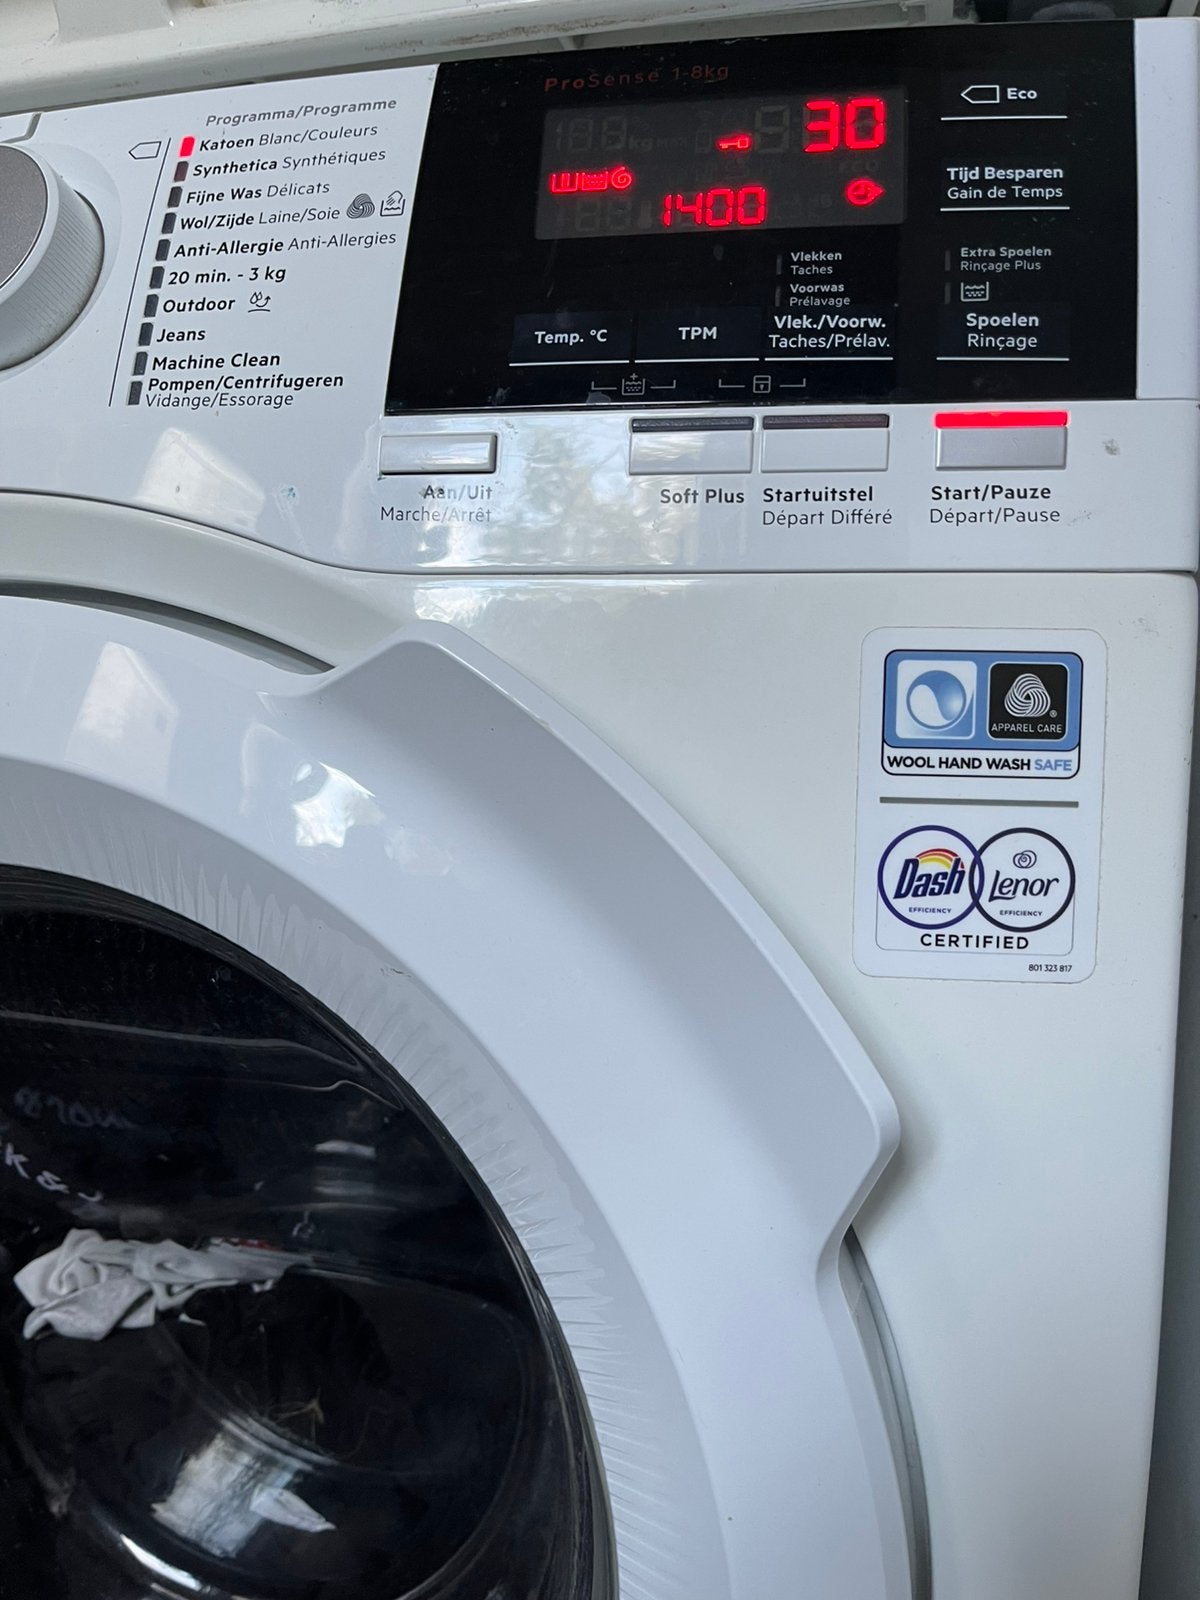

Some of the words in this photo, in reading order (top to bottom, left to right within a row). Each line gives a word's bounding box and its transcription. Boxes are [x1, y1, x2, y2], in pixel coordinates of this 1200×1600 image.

[544, 67, 660, 93] ProSense
[1006, 88, 1038, 100] Eco
[205, 98, 397, 127] Programma/Programme
[803, 97, 886, 153] 30
[199, 136, 254, 152] Katoen
[258, 124, 378, 147] Blanc/Couleurs
[193, 159, 277, 178] Synthetica
[282, 149, 386, 171] Synthétiques
[947, 167, 980, 183] Tijd
[984, 166, 1064, 183] Besparen
[186, 189, 225, 206] Fijne
[230, 186, 262, 200] Was
[266, 181, 330, 198] Délicats
[947, 186, 983, 200] Gain
[987, 186, 1007, 199] de
[1011, 185, 1063, 200] Temps
[662, 186, 767, 228] 1400
[180, 213, 255, 230] Wol/Zijde
[258, 207, 340, 225] Laine/Soie
[173, 238, 284, 258] Anti-Allergie
[287, 231, 397, 252] Anti-Allergies
[960, 247, 996, 258] Extra
[999, 246, 1052, 259] Spoelen
[790, 251, 842, 262] Vlekken
[790, 264, 833, 276] Taches
[960, 260, 1011, 272] Rinçage
[1014, 259, 1041, 271] Plus
[168, 271, 190, 285] 20
[196, 269, 231, 285] min.
[248, 267, 259, 281] 3
[264, 266, 286, 283] kg
[790, 282, 845, 294] Voorwas
[163, 297, 236, 313] Outdoor
[789, 294, 850, 307] Prélavage
[773, 313, 886, 330] Vlek./Voorw.
[966, 312, 1040, 329] Spoelen
[156, 328, 206, 343] Jeans
[534, 329, 584, 346] Temp.
[590, 328, 608, 343] °C
[678, 326, 718, 341] TPM
[768, 332, 890, 349] Taches/Prélav.
[967, 333, 1038, 351] Rinçage
[151, 356, 225, 371] Machine
[230, 353, 281, 367] Clean
[148, 373, 344, 392] Pompen/Centrifugeren
[145, 392, 294, 409] Vidange/Essorage
[423, 485, 493, 501] Aan/Uit
[660, 488, 699, 505] Soft
[705, 488, 745, 504] Plus
[763, 486, 874, 504] Startuitstel
[931, 484, 1051, 502] Start/Pauze
[380, 506, 492, 523] Marche/Arrêt
[762, 508, 824, 527] Départ
[831, 508, 892, 526] Différé
[930, 507, 1061, 526] Départ/Pause
[991, 723, 1035, 733] APPAREL
[1037, 723, 1063, 734] CARE
[887, 755, 936, 769] WOOL
[938, 756, 983, 770] HAND
[985, 758, 1031, 771] WASH
[1034, 758, 1073, 772] SAFE
[893, 857, 966, 899] Dash
[988, 869, 1060, 902] Lenor
[908, 906, 952, 914] EFFICIENCY
[999, 909, 1043, 917] EFFICIENCY
[920, 933, 1030, 950] CERTIFIED
[1028, 964, 1043, 972] 801
[1044, 964, 1058, 972] 323
[1059, 964, 1073, 972] 817
